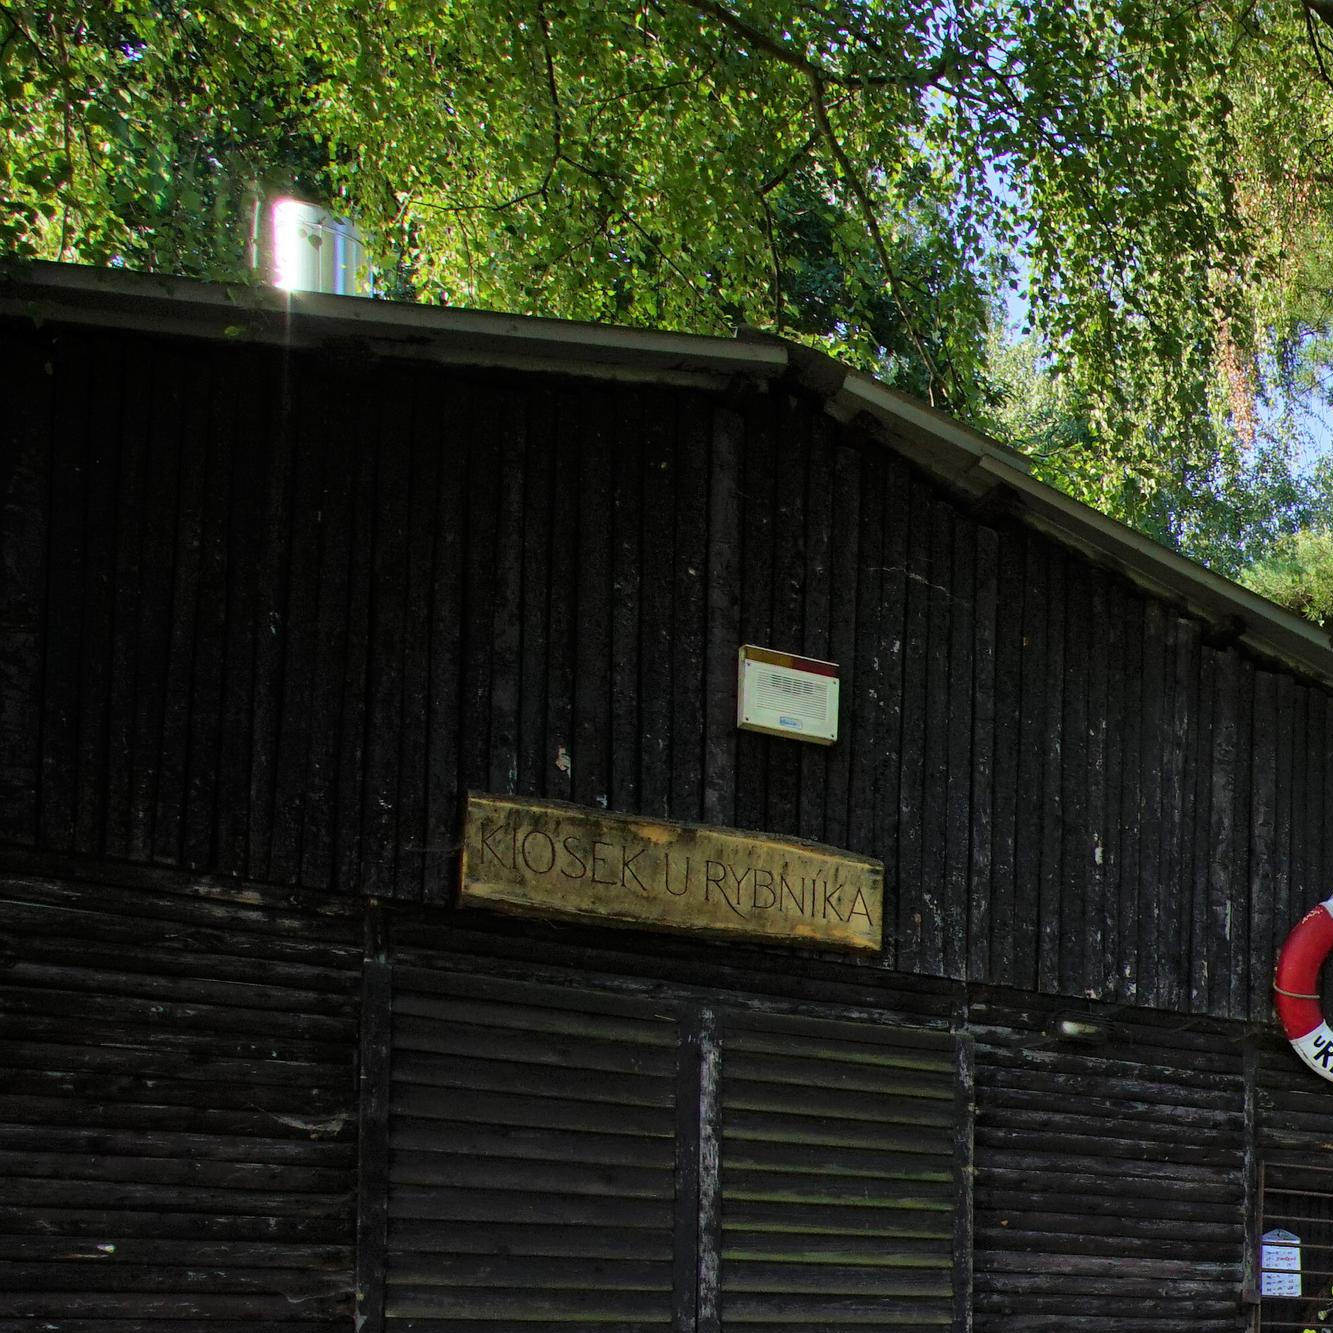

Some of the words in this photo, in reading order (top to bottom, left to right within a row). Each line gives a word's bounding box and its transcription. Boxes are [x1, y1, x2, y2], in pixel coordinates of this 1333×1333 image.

[480, 822, 648, 892] KIOSEK
[664, 852, 691, 897] U
[704, 859, 874, 926] RYBNÍKA
